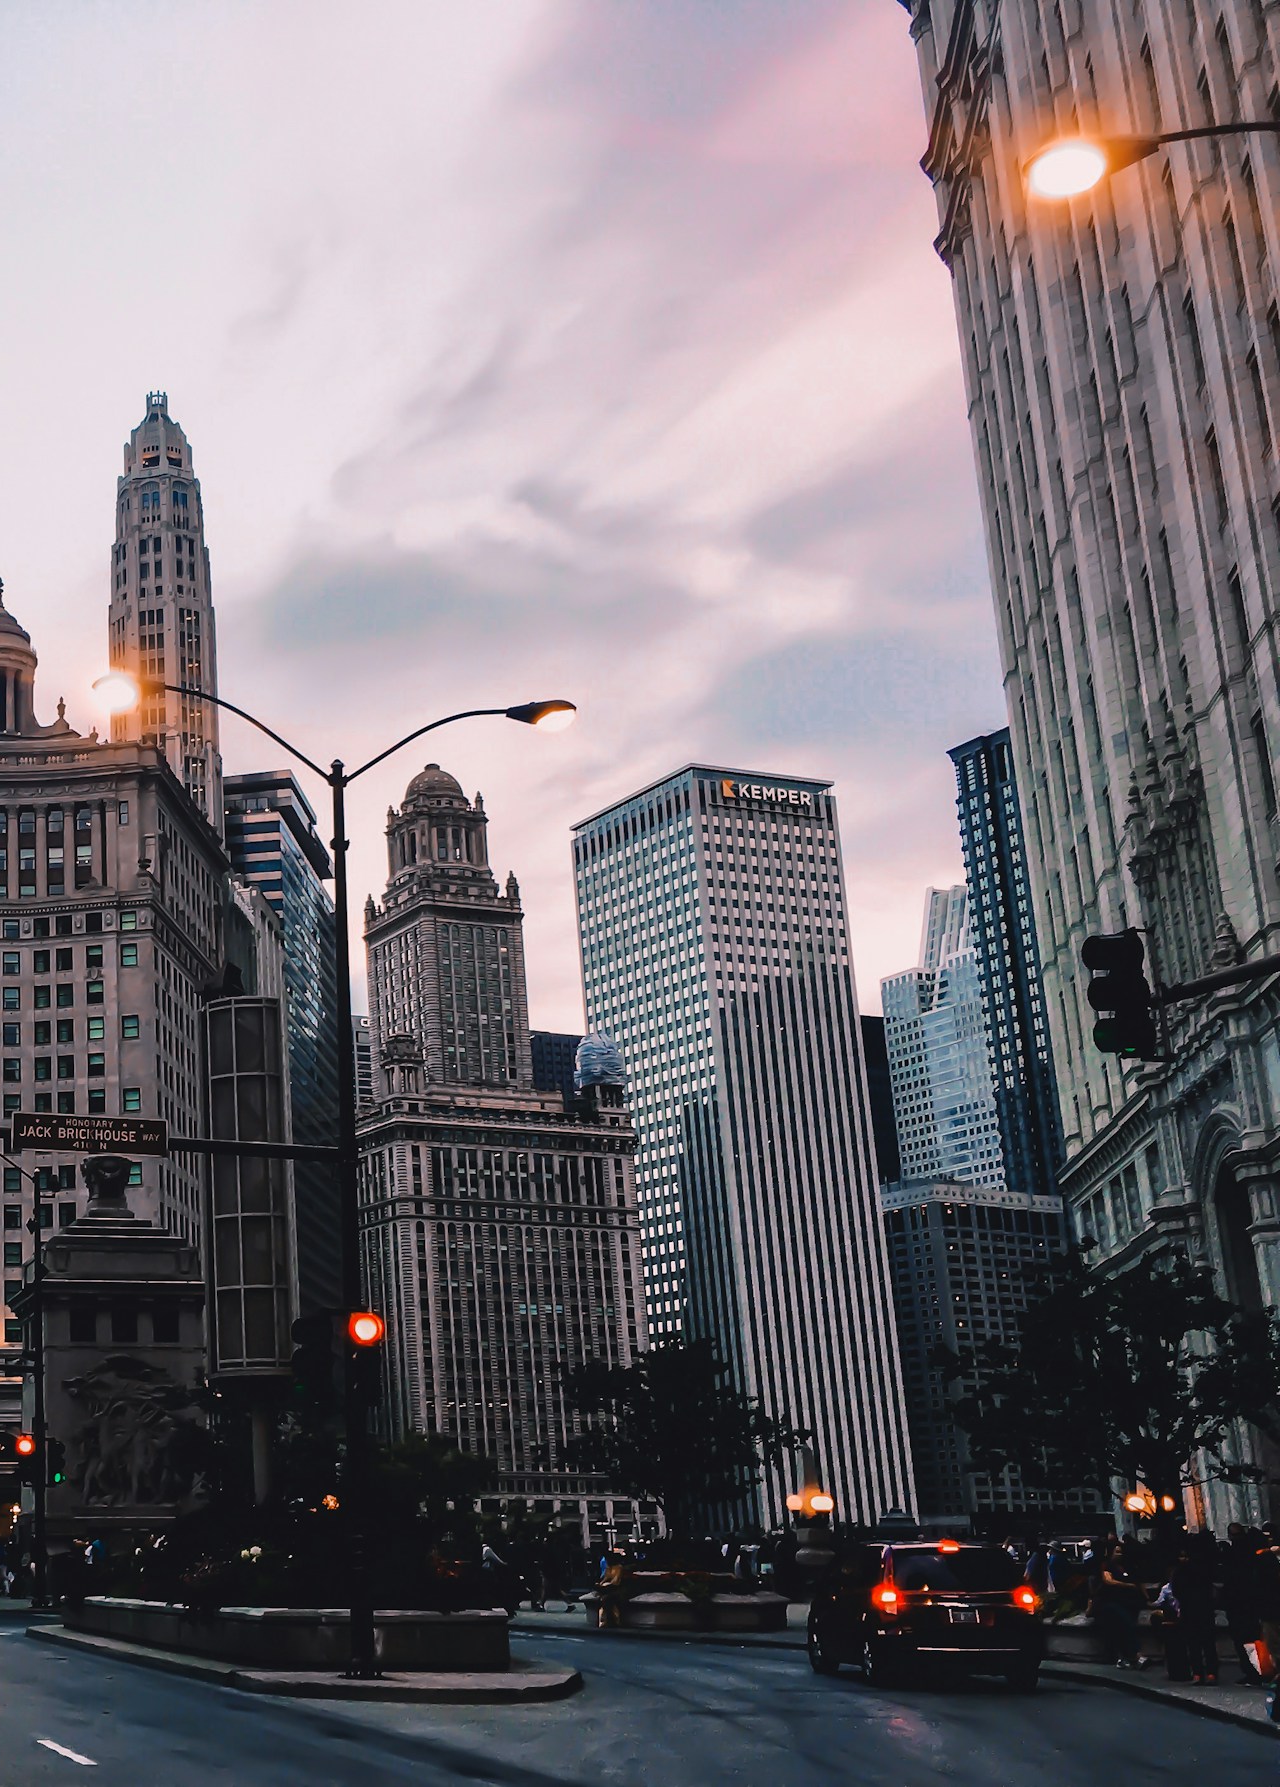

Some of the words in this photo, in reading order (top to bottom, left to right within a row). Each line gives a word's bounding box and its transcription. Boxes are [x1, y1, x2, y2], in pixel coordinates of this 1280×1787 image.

[738, 783, 812, 806] KEMPER
[65, 1118, 114, 1129] HONORARY
[19, 1125, 52, 1139] JACK
[58, 1127, 137, 1143] BRICKHOUSE
[142, 1133, 160, 1142] WAY
[99, 1142, 108, 1150] N
